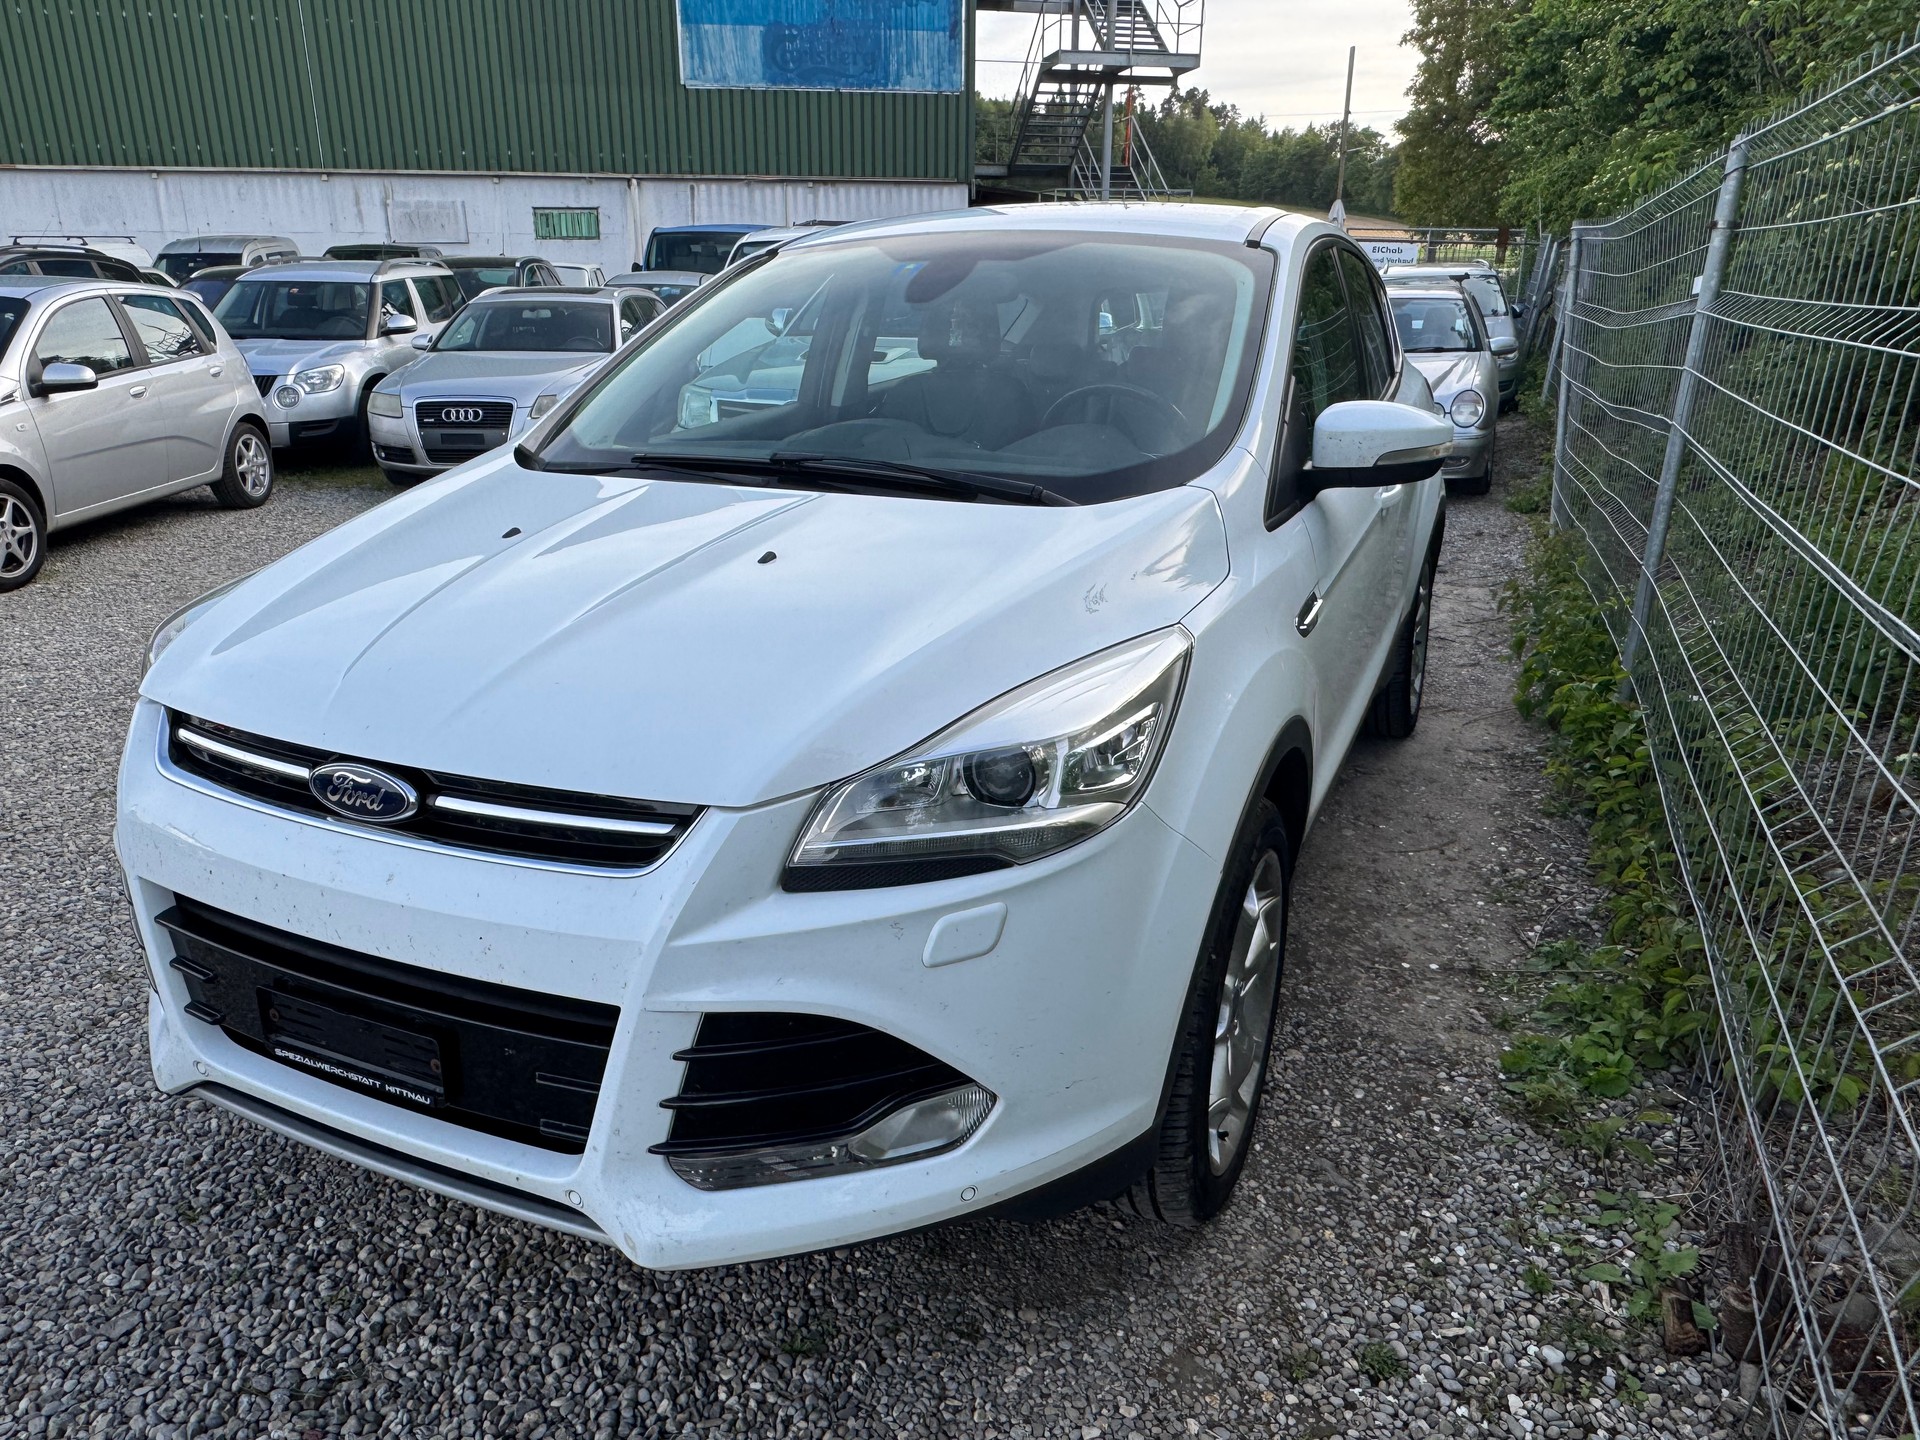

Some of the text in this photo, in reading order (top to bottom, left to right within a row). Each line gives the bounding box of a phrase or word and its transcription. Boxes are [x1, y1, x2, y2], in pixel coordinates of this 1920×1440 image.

[327, 772, 385, 811] Ford
[275, 1048, 431, 1105] SPEZIALWERCHSTATT HITTNAU
